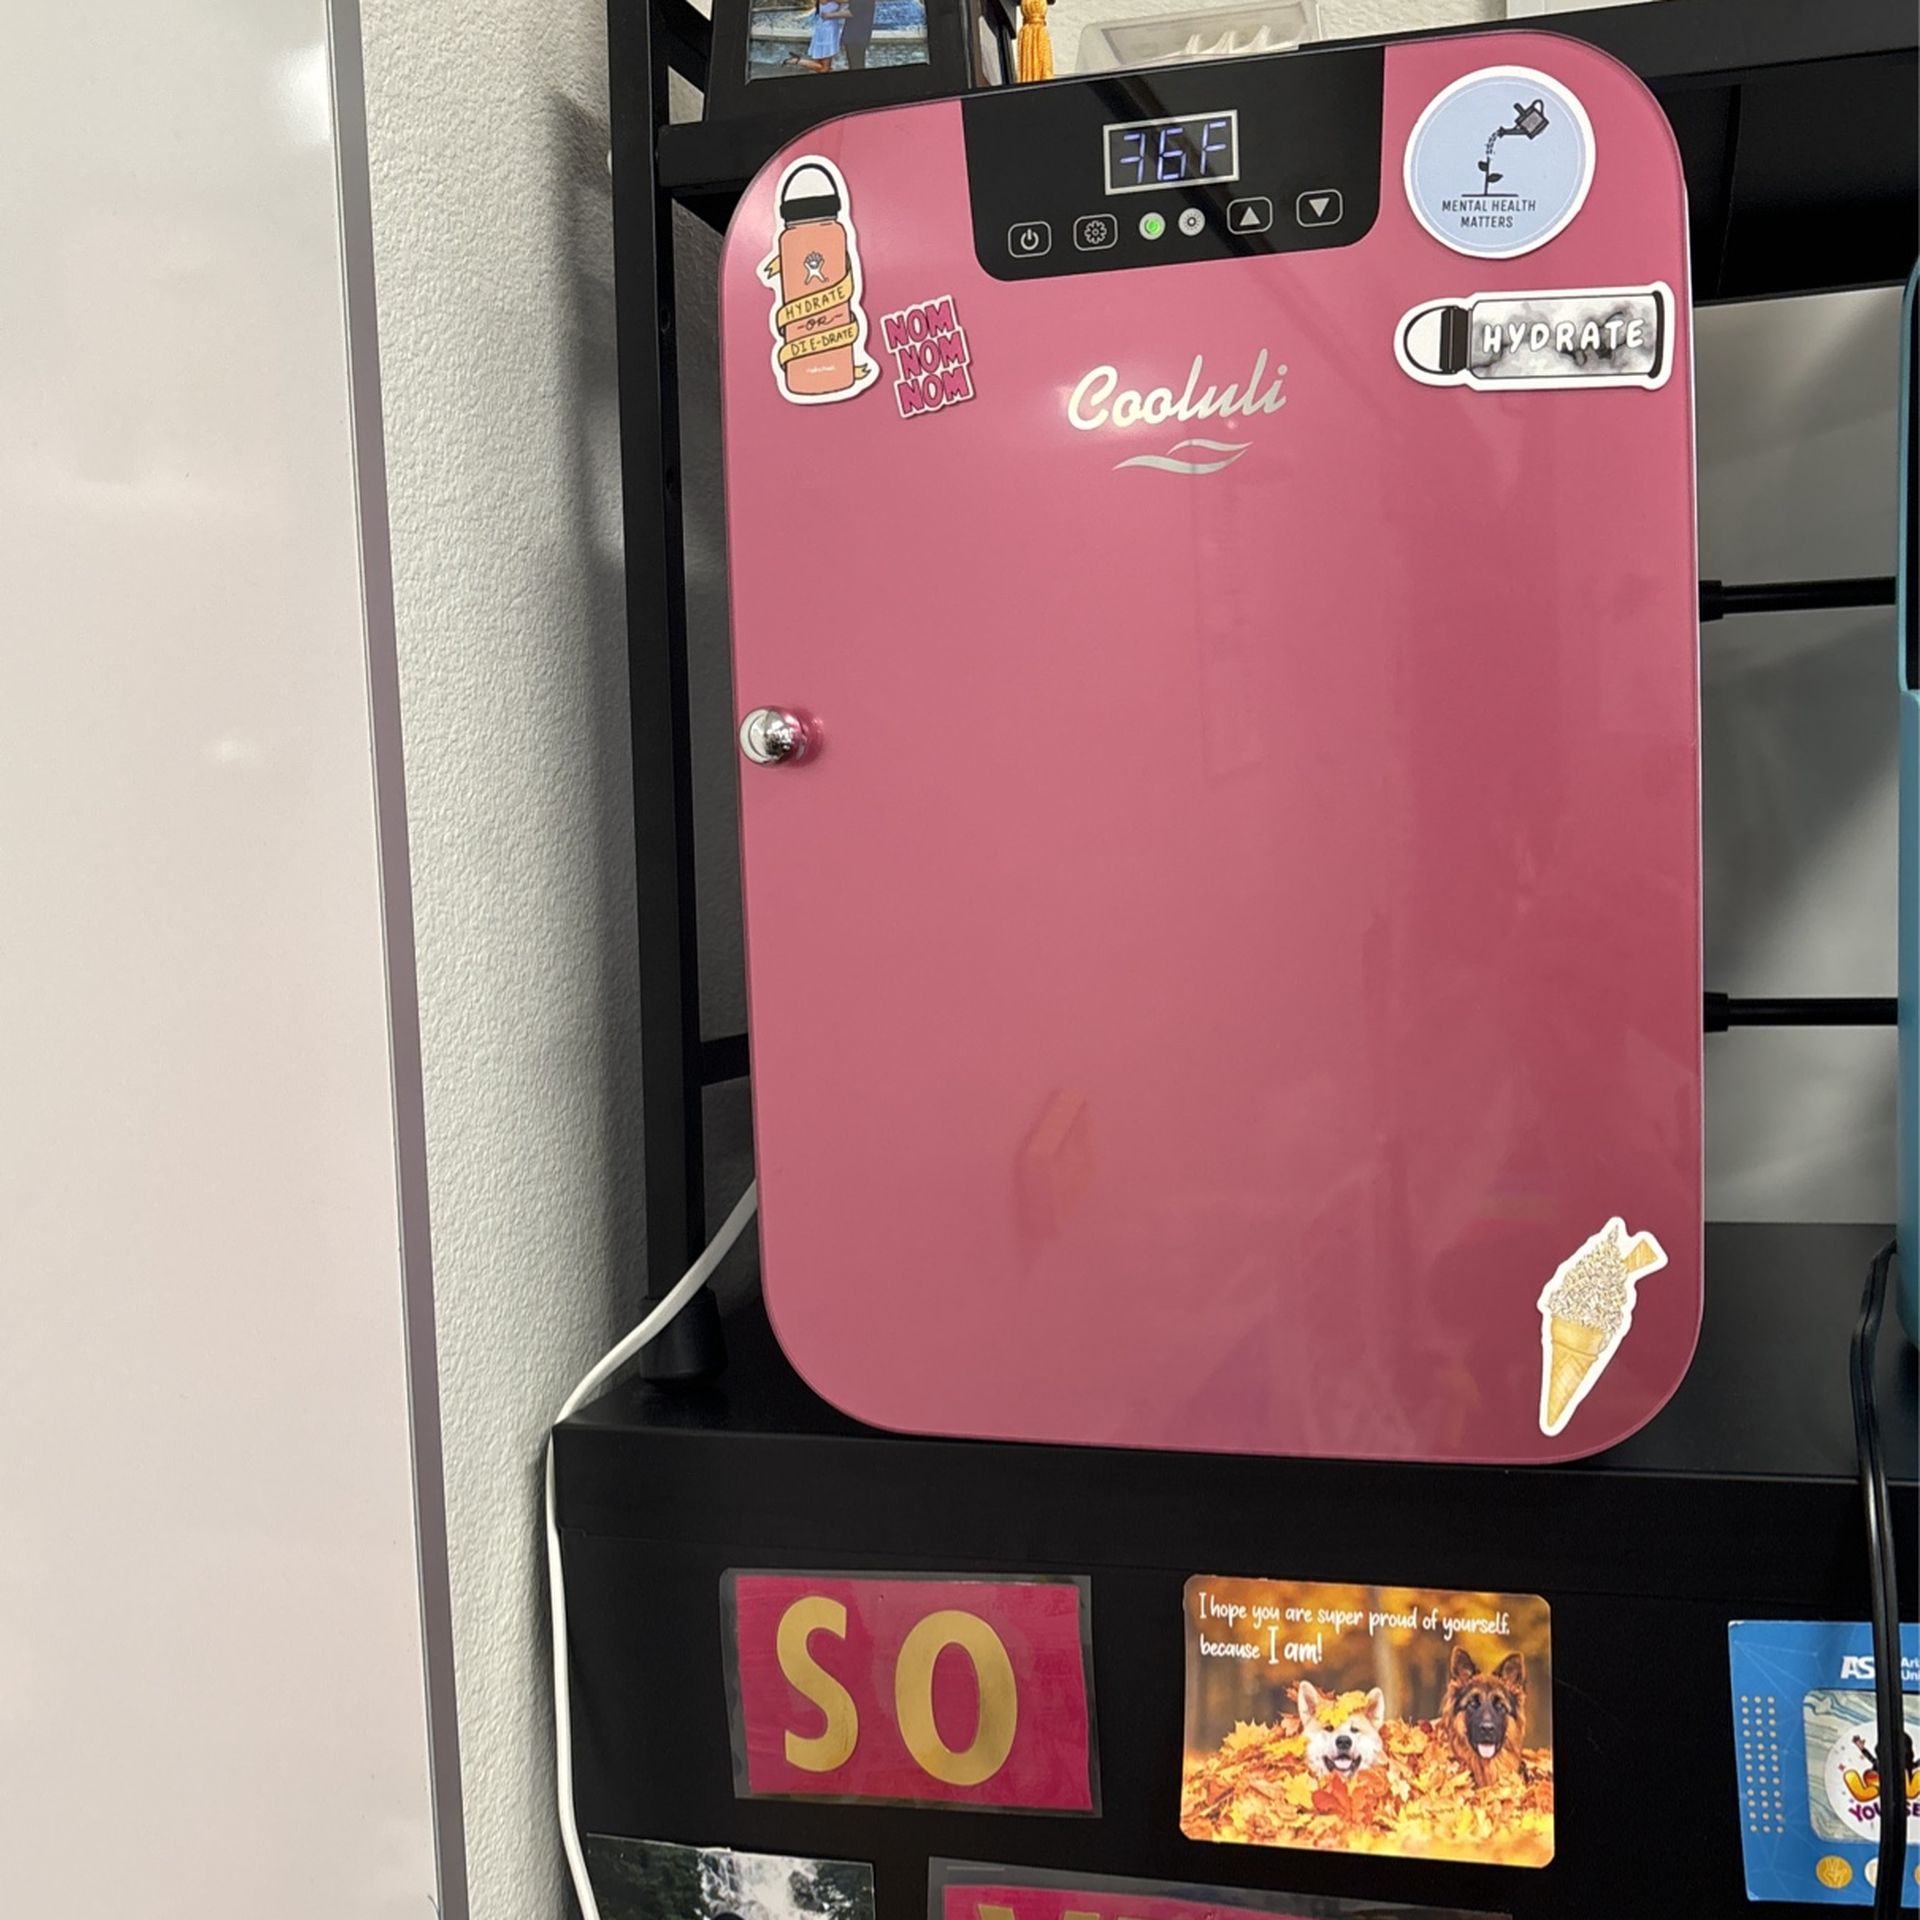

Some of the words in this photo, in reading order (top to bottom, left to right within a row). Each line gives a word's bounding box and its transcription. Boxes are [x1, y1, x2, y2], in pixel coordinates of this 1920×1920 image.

[1441, 200, 1488, 213] MENTAL
[1491, 199, 1537, 213] HEALTH
[1460, 215, 1514, 229] MATTERS
[785, 285, 847, 321] HYDRATE
[790, 326, 854, 358] DIE-DRATE
[884, 300, 956, 350] NOM
[1482, 319, 1645, 353] HYDRATE
[898, 331, 967, 380] NOM
[896, 366, 970, 415] NOM
[1067, 348, 1289, 430] Cooluli
[1199, 1591, 1208, 1620] I
[1210, 1595, 1247, 1628] hope
[1252, 1604, 1280, 1629] you
[1285, 1607, 1312, 1623] are
[1317, 1607, 1364, 1634] super
[1369, 1606, 1418, 1636] proud
[1422, 1608, 1439, 1631] of
[1199, 1633, 1260, 1659] because
[1268, 1626, 1279, 1664] I
[1284, 1632, 1323, 1664] am!
[1840, 1655, 1876, 1680] AS
[776, 1596, 1018, 1786] SO
